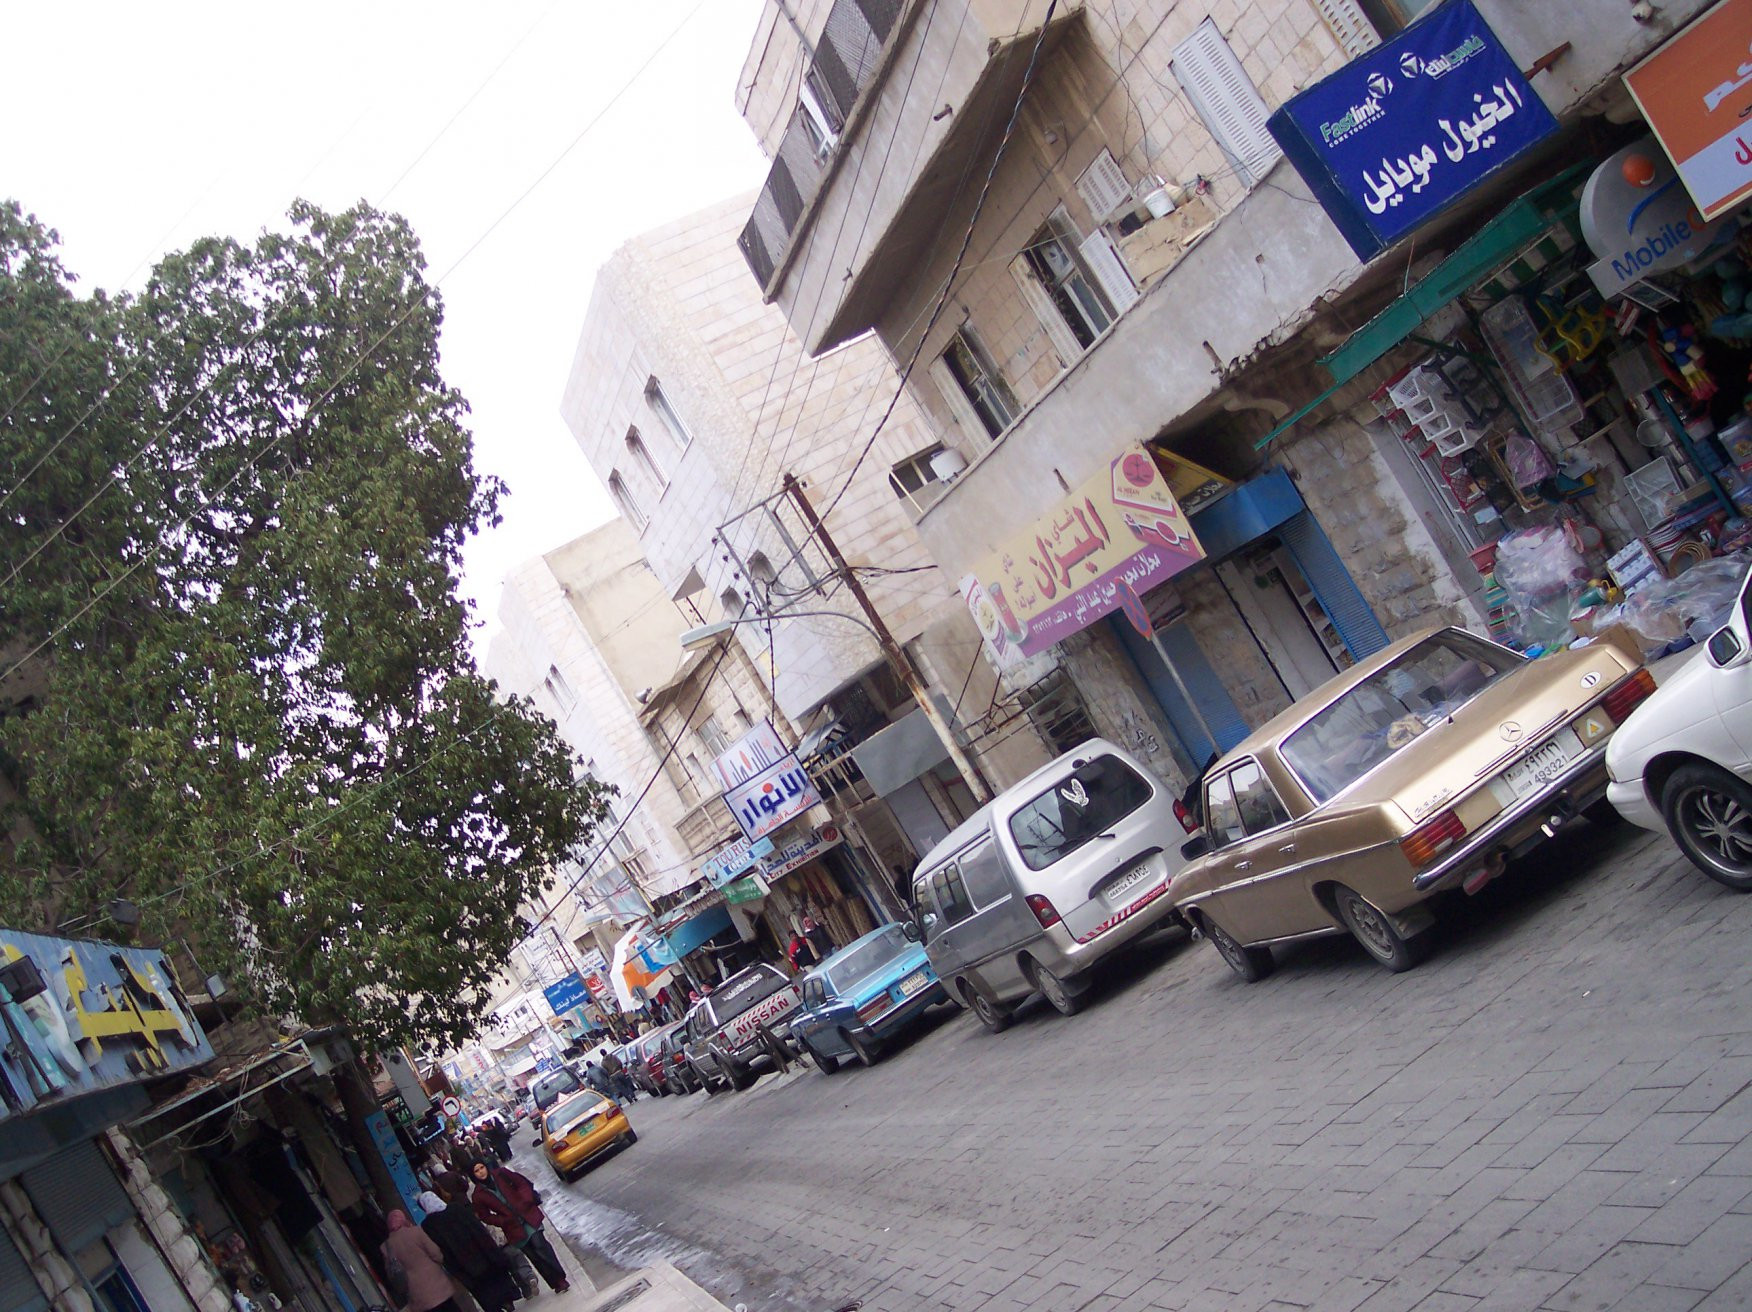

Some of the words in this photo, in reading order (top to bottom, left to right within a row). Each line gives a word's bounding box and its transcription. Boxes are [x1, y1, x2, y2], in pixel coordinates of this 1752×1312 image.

[1319, 97, 1382, 144] Fastlink
[1329, 132, 1349, 148] COME
[1349, 110, 1386, 136] TOGETHER
[1438, 77, 1523, 163] الخيول
[1362, 144, 1438, 215] موبايل
[1052, 509, 1075, 545] شاي
[1034, 495, 1111, 600] الميزان
[1134, 552, 1161, 576] محلات
[1584, 675, 1597, 686] D
[1534, 755, 1568, 783] 493321
[713, 838, 752, 867] TOURIS
[736, 998, 789, 1036] NISSAN
